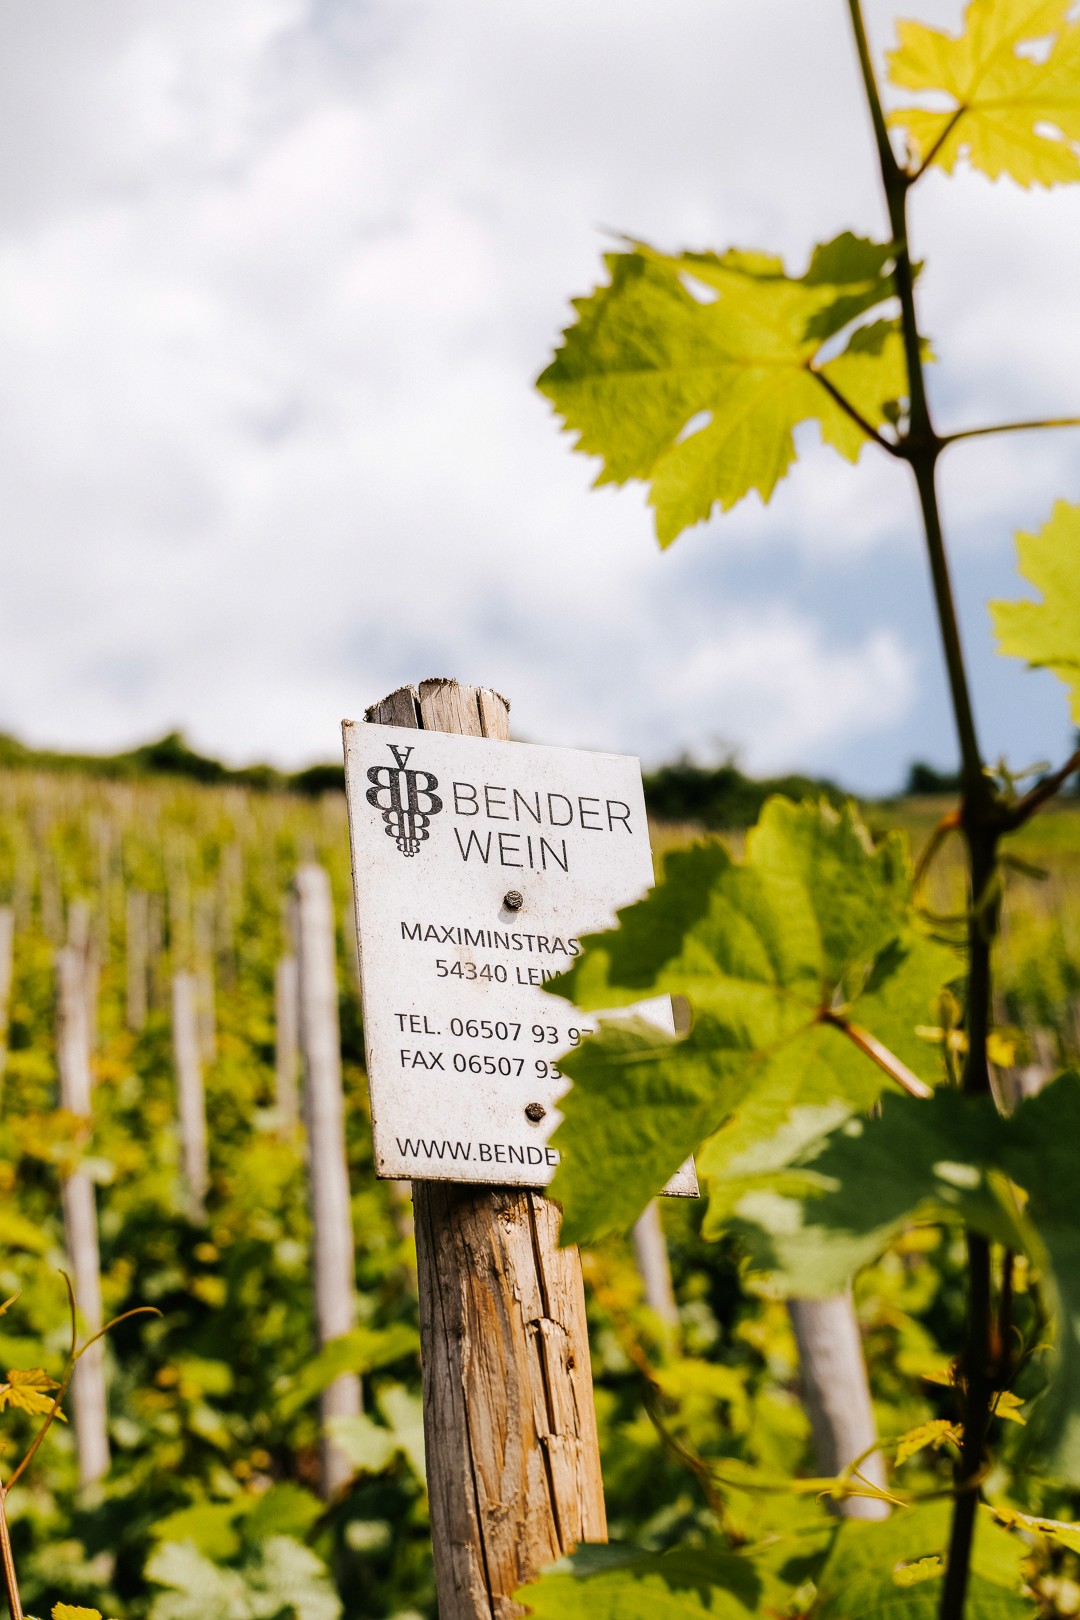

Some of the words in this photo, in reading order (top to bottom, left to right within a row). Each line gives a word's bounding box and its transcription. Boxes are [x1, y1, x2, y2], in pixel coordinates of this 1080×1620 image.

[452, 781, 633, 834] BENDER
[453, 827, 569, 873] WEIN
[436, 959, 508, 983] 54340
[394, 1013, 441, 1035] TEL.
[450, 1017, 522, 1041] 06507
[531, 1024, 559, 1045] 93
[400, 1049, 446, 1071] FAX
[453, 1053, 525, 1077] 06507
[395, 1137, 562, 1167] WWW.BENDE
